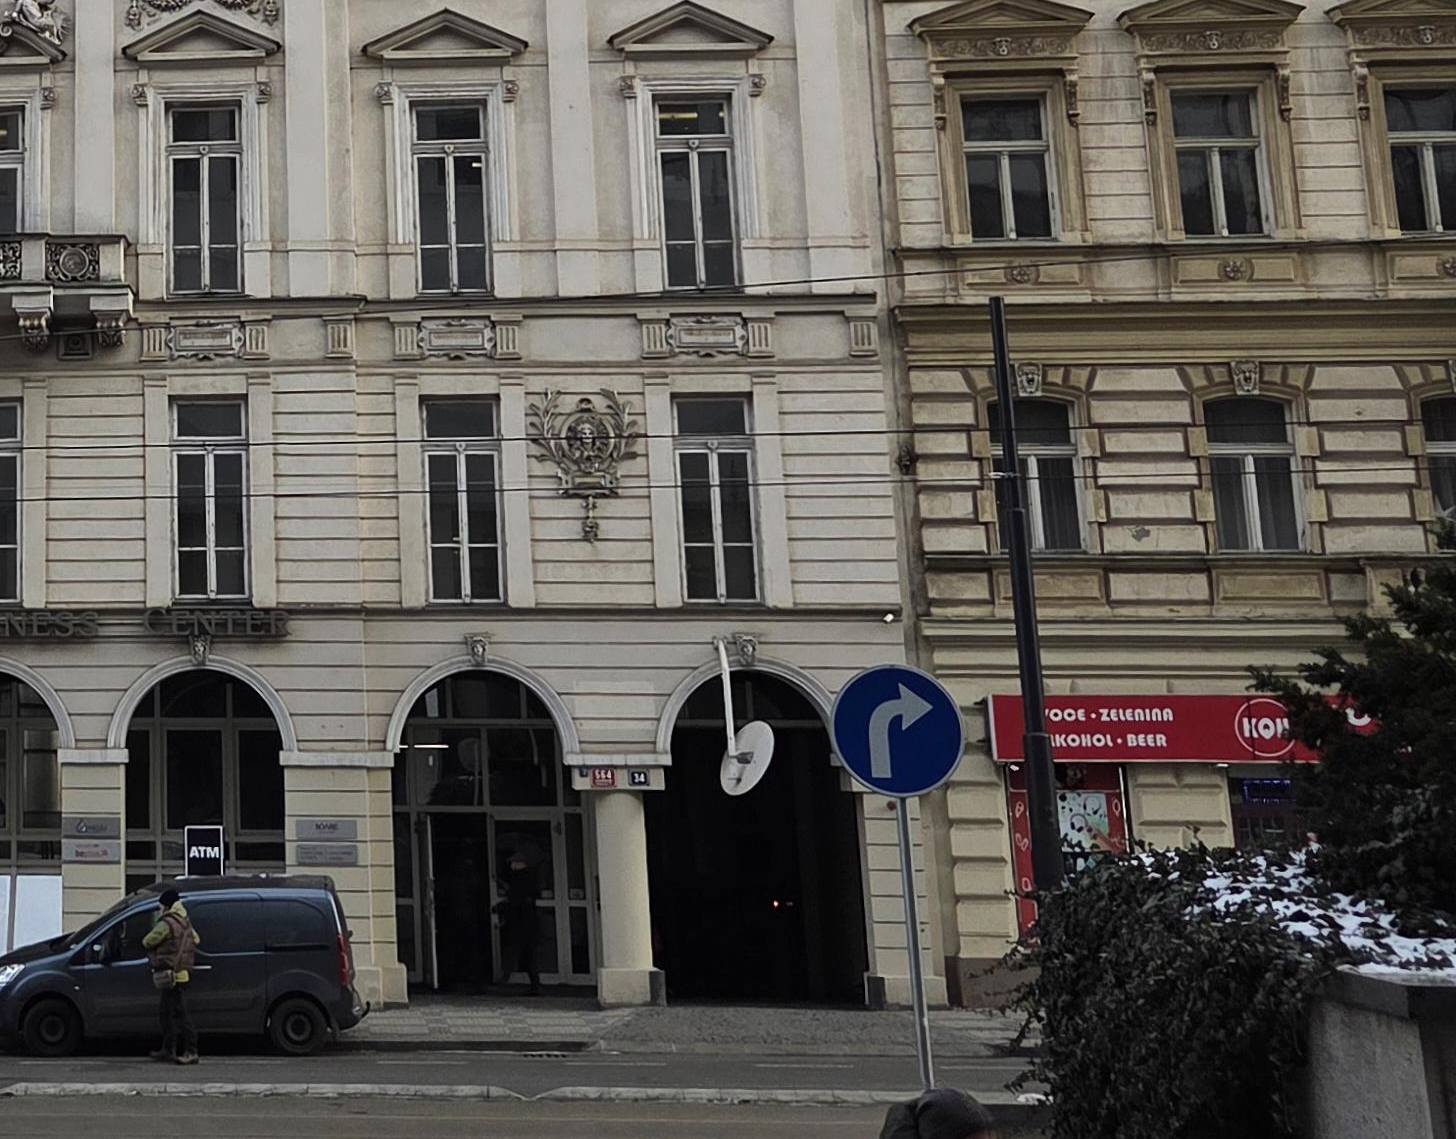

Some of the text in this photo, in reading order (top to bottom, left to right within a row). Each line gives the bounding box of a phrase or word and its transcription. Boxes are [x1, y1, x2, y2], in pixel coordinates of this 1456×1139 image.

[143, 608, 292, 637] CENTER
[1099, 708, 1174, 721] ZELENINA
[1126, 733, 1168, 747] BEER
[189, 846, 220, 859] ATM
